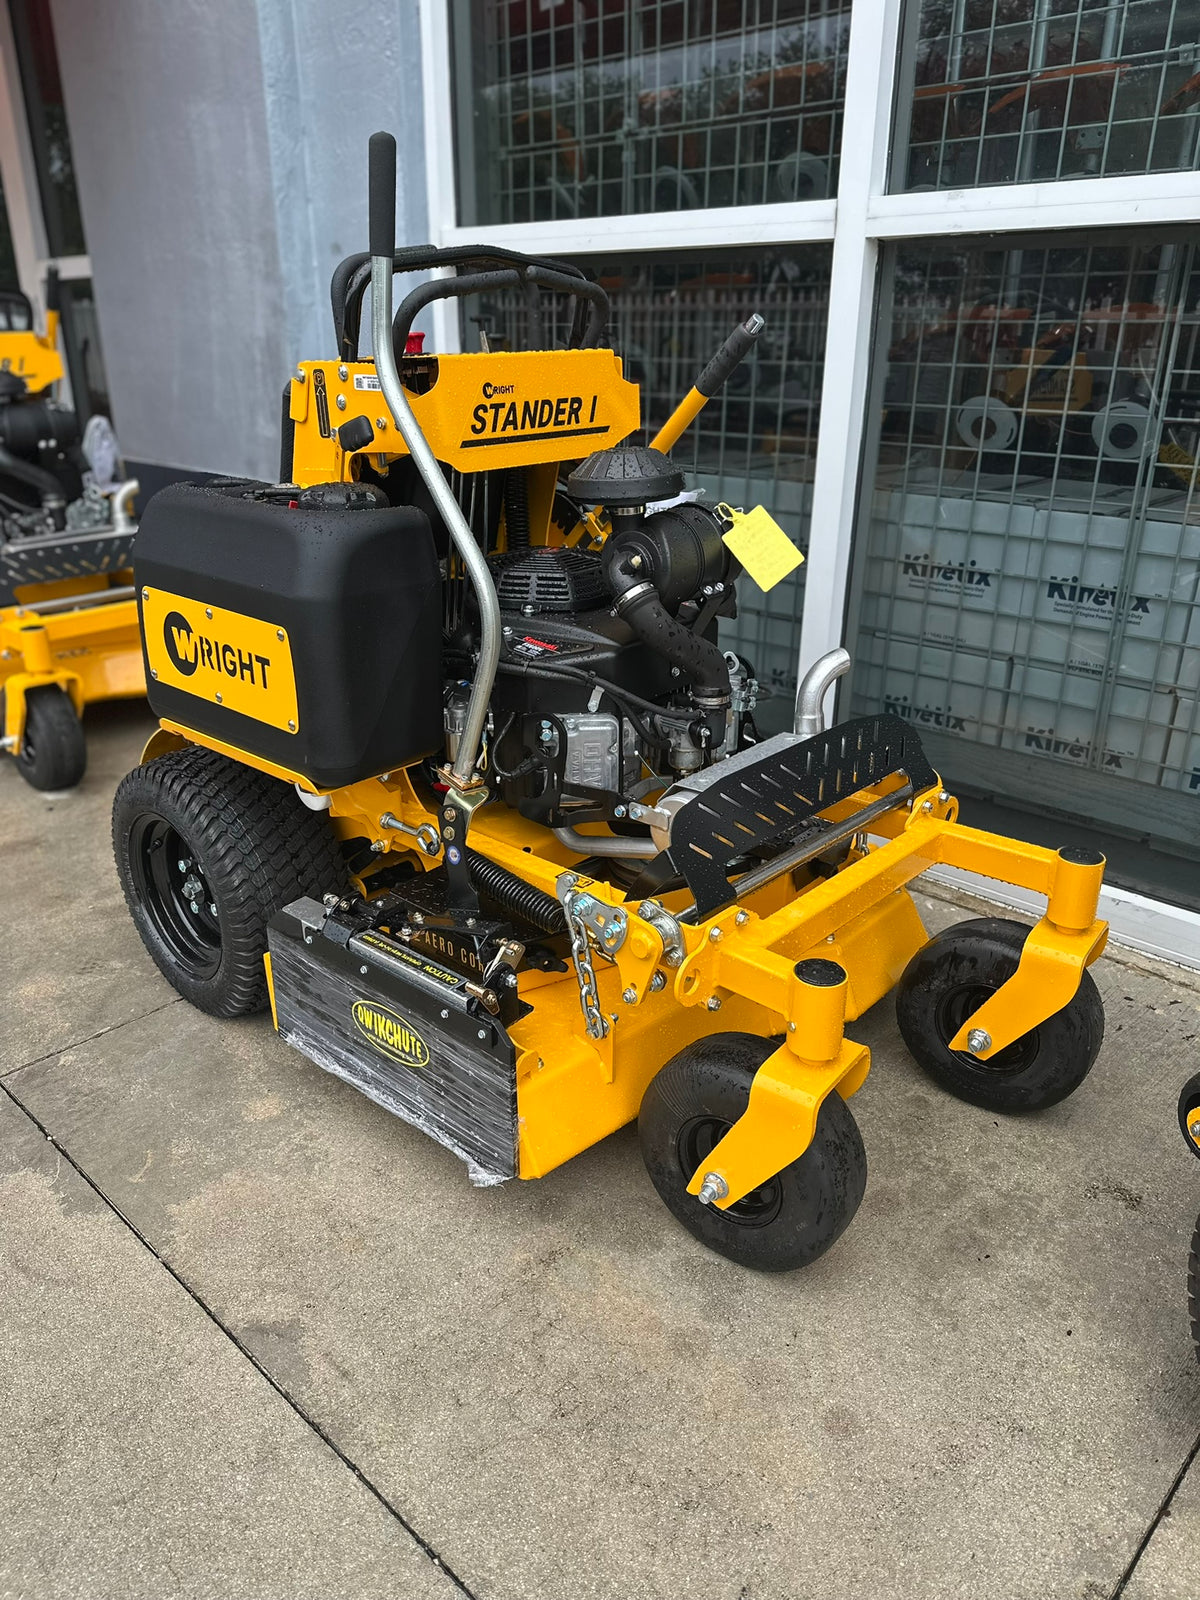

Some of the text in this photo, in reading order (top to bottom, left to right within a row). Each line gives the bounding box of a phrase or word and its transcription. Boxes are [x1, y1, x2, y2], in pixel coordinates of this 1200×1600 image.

[482, 382, 515, 399] WRIGHT
[470, 395, 598, 435] STANDER I
[903, 553, 991, 587] Kinetix
[164, 611, 271, 690] WRIGHT
[883, 694, 966, 732] Kinetix
[1024, 726, 1123, 769] Kinetx
[425, 930, 454, 957] AERO
[357, 1004, 422, 1059] QWIKCHUTE
